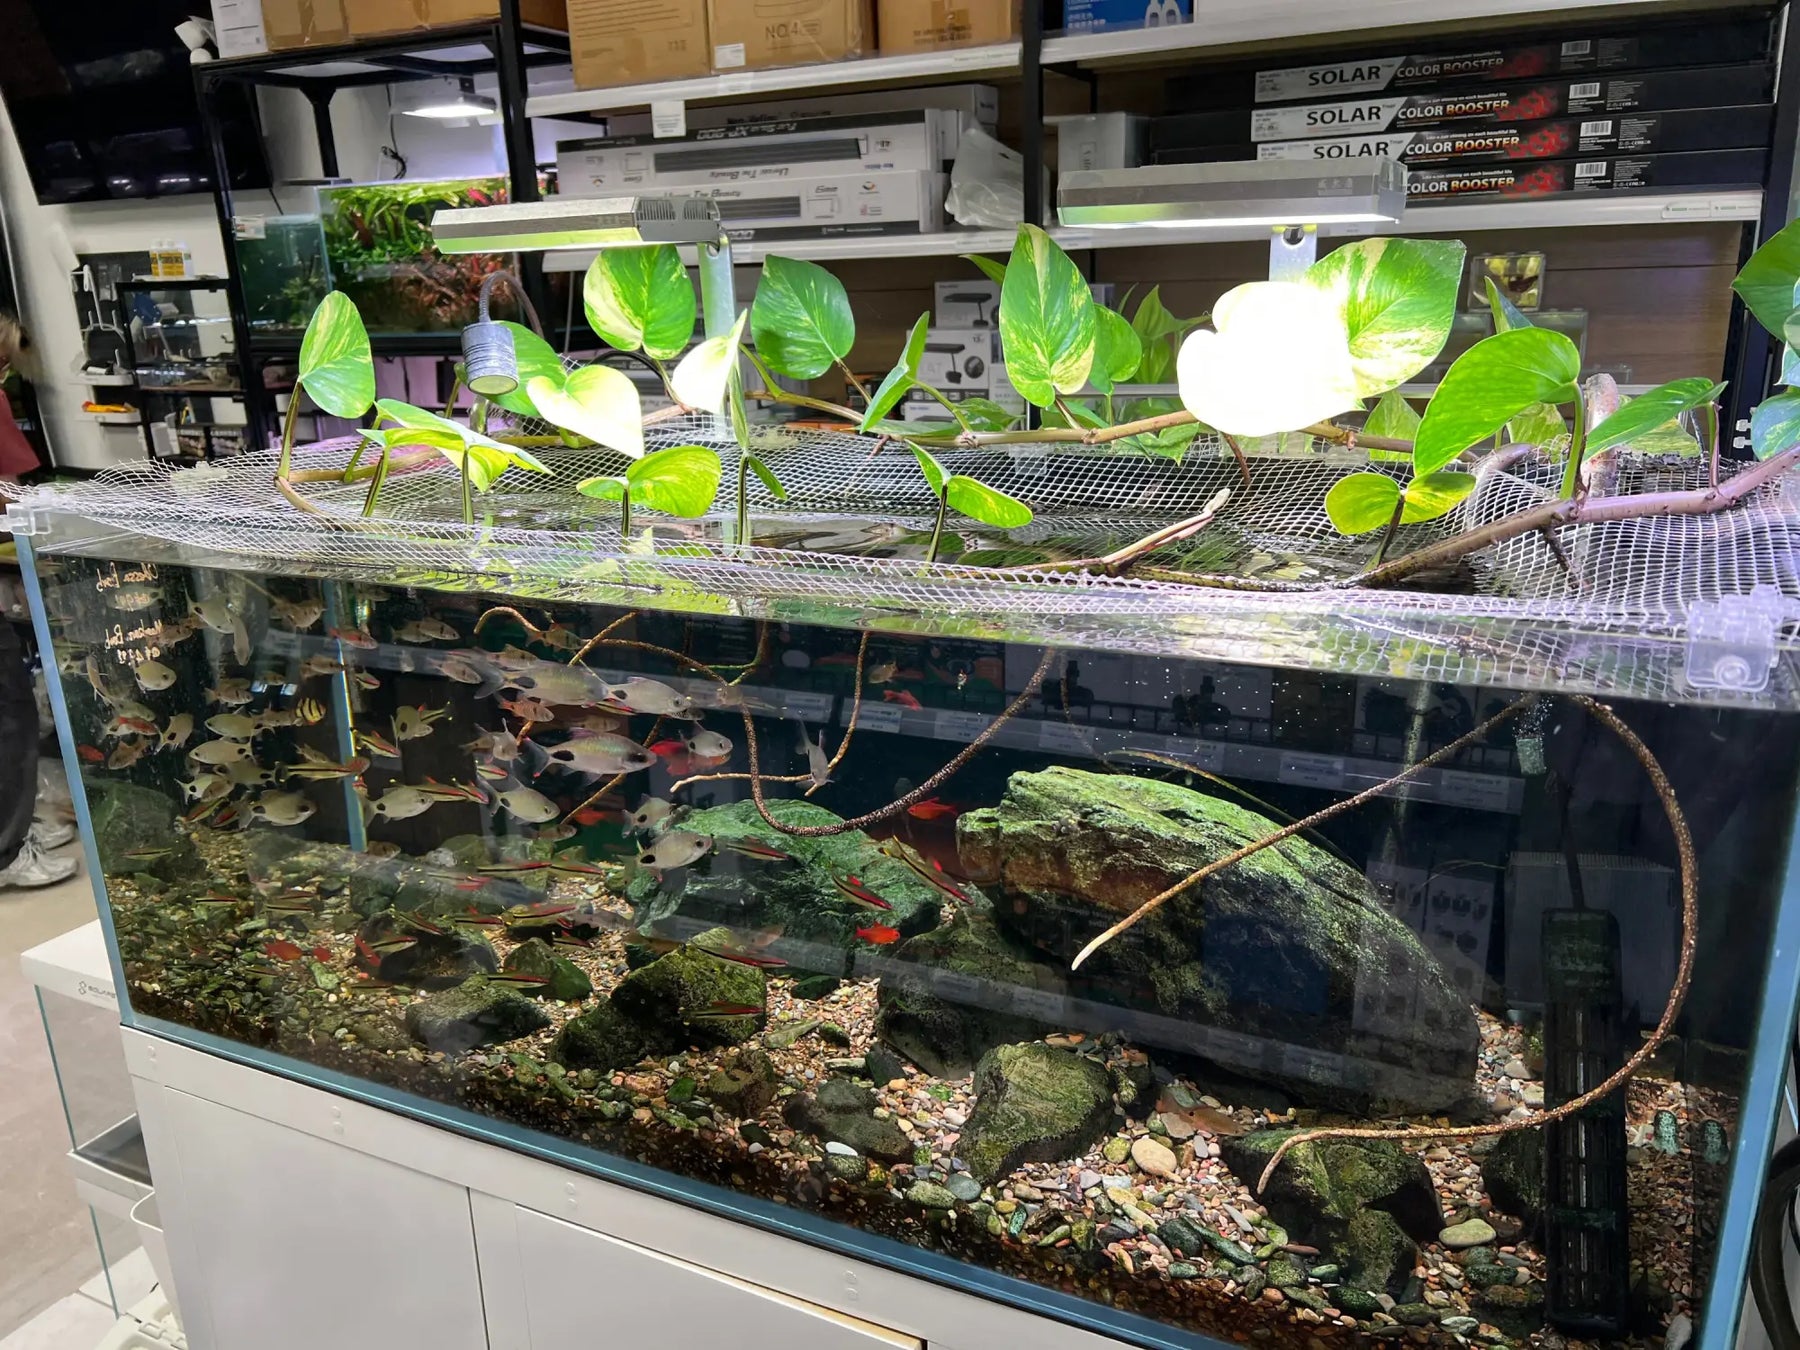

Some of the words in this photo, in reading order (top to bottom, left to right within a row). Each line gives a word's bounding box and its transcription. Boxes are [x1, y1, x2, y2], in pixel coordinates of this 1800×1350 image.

[1308, 65, 1381, 86] SOLAR
[1397, 64, 1440, 78] COLOR
[1443, 58, 1504, 75] BOOSTER
[1306, 104, 1381, 126] SOLAR
[1398, 105, 1443, 119] COLOR
[1446, 99, 1509, 115] BOOSTER
[1313, 141, 1389, 159] SOLAR
[1406, 142, 1452, 156] COLOR
[1455, 136, 1519, 151] BOOSTER
[1451, 176, 1515, 191] BOOSTER
